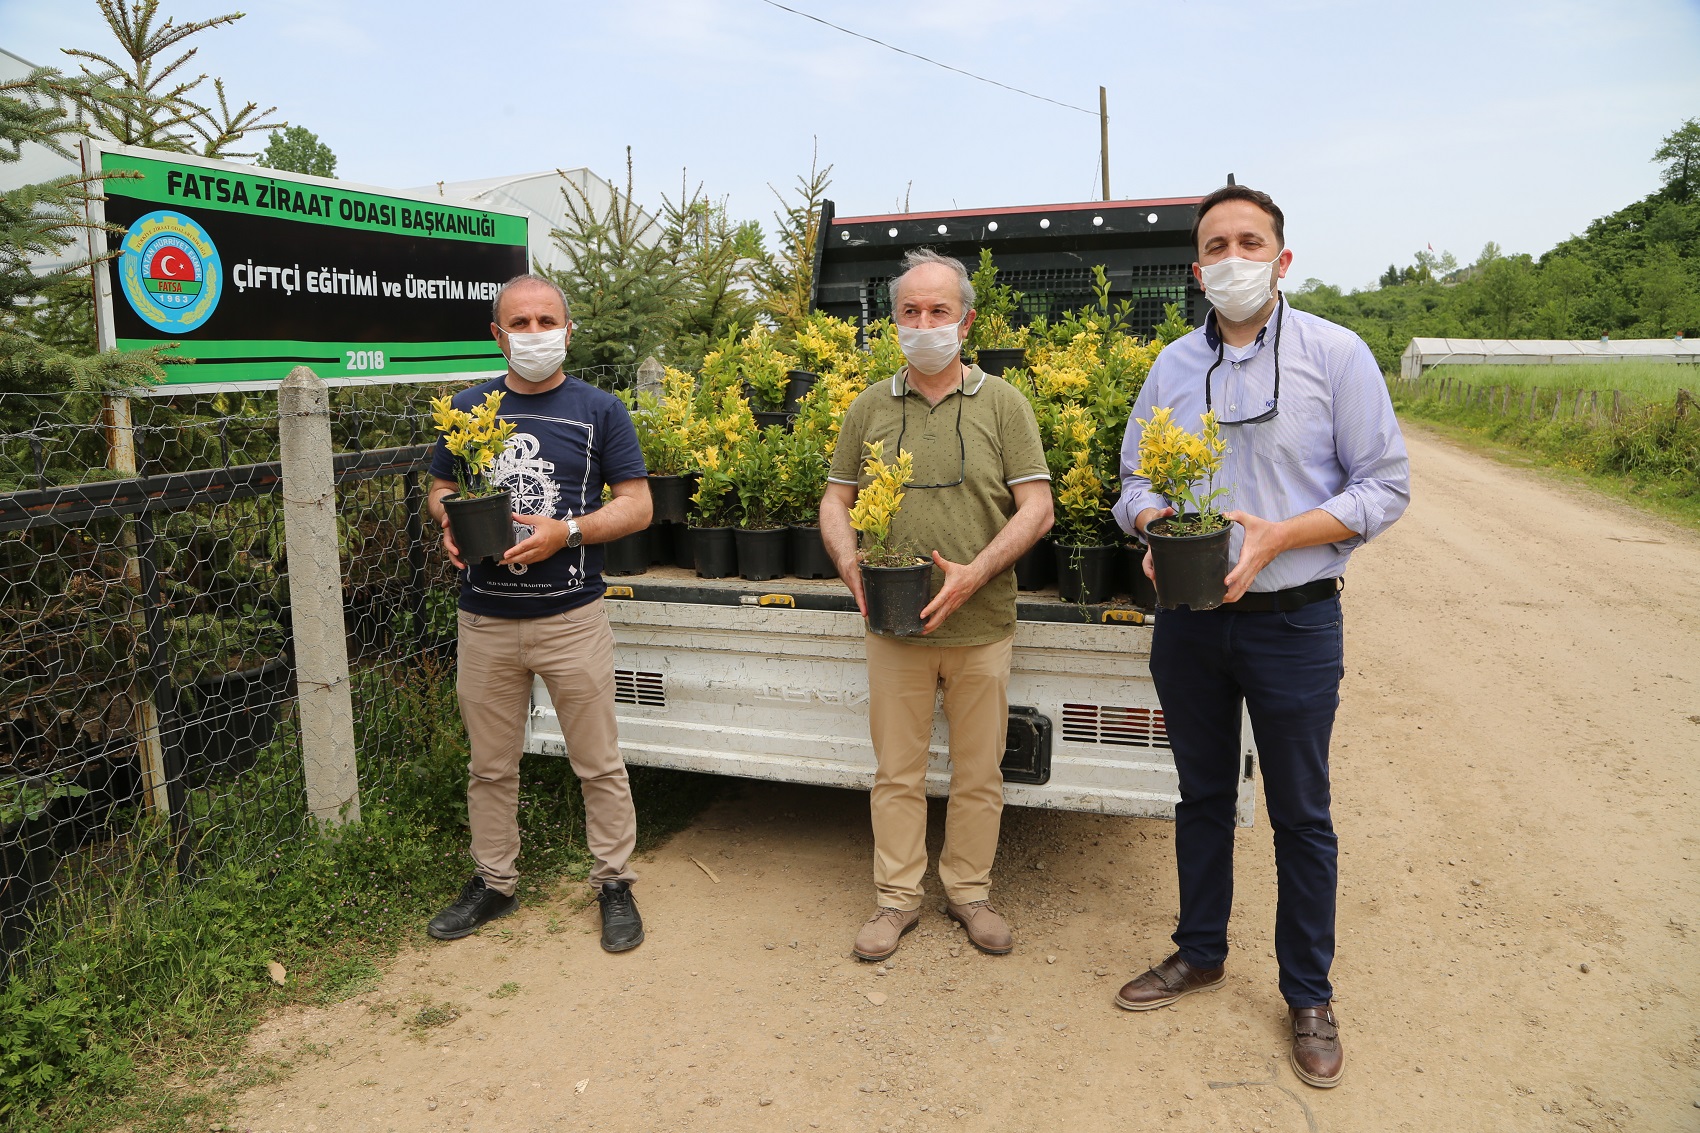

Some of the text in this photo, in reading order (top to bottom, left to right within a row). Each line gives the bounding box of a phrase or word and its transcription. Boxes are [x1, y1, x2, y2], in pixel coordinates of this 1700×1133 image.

[167, 170, 495, 238] FATSA ZİRAAT ODASI BAŞKANLIĞI
[143, 237, 202, 280] VATAN HÜRRİYET EKMEK
[158, 281, 183, 293] FATSA
[232, 258, 301, 296] ÇİFTÇİ
[306, 266, 378, 297] EĞİTİMİ
[381, 281, 402, 298] ve
[405, 273, 465, 300] ÜRETİM
[159, 294, 188, 303] 1963
[346, 350, 385, 370] 2018
